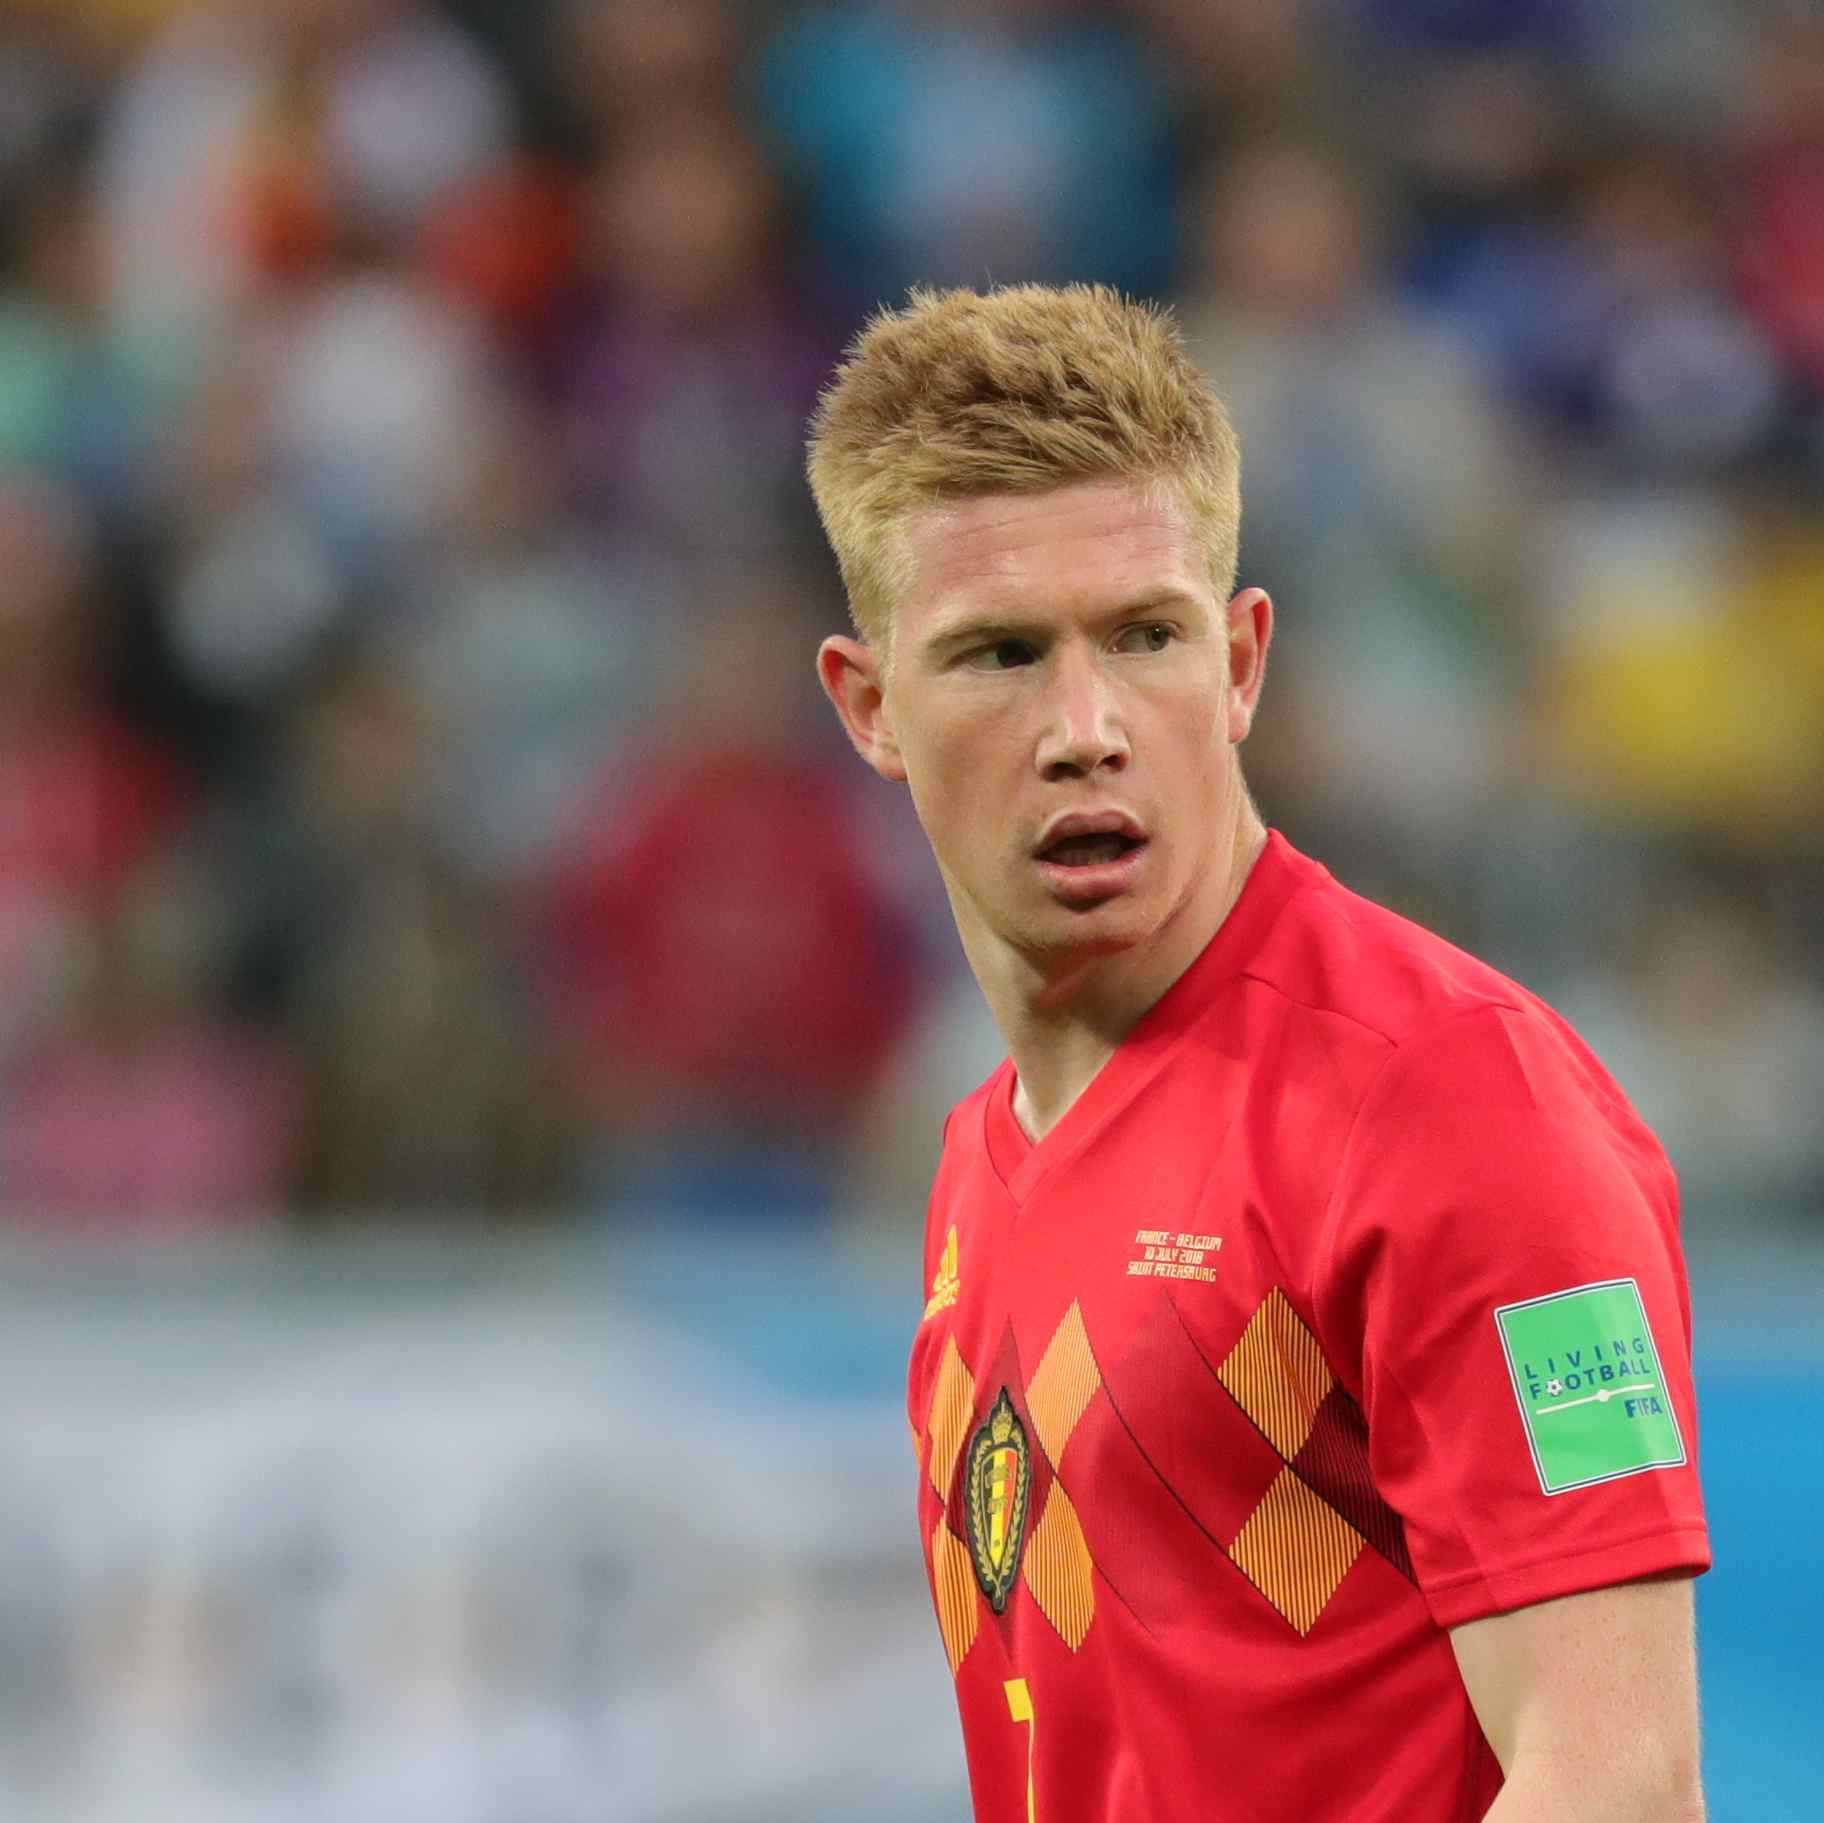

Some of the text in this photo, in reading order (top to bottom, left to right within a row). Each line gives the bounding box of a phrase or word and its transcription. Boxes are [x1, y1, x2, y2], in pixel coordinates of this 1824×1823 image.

[1136, 1230, 1169, 1246] FRANCE
[1176, 1233, 1222, 1251] BELGIUM
[1144, 1246, 1204, 1264] 10 JULY 2018
[1127, 1261, 1216, 1282] SAINT PETERSBURG
[1524, 1338, 1644, 1379] LIVING
[1624, 1397, 1663, 1418] FIFA
